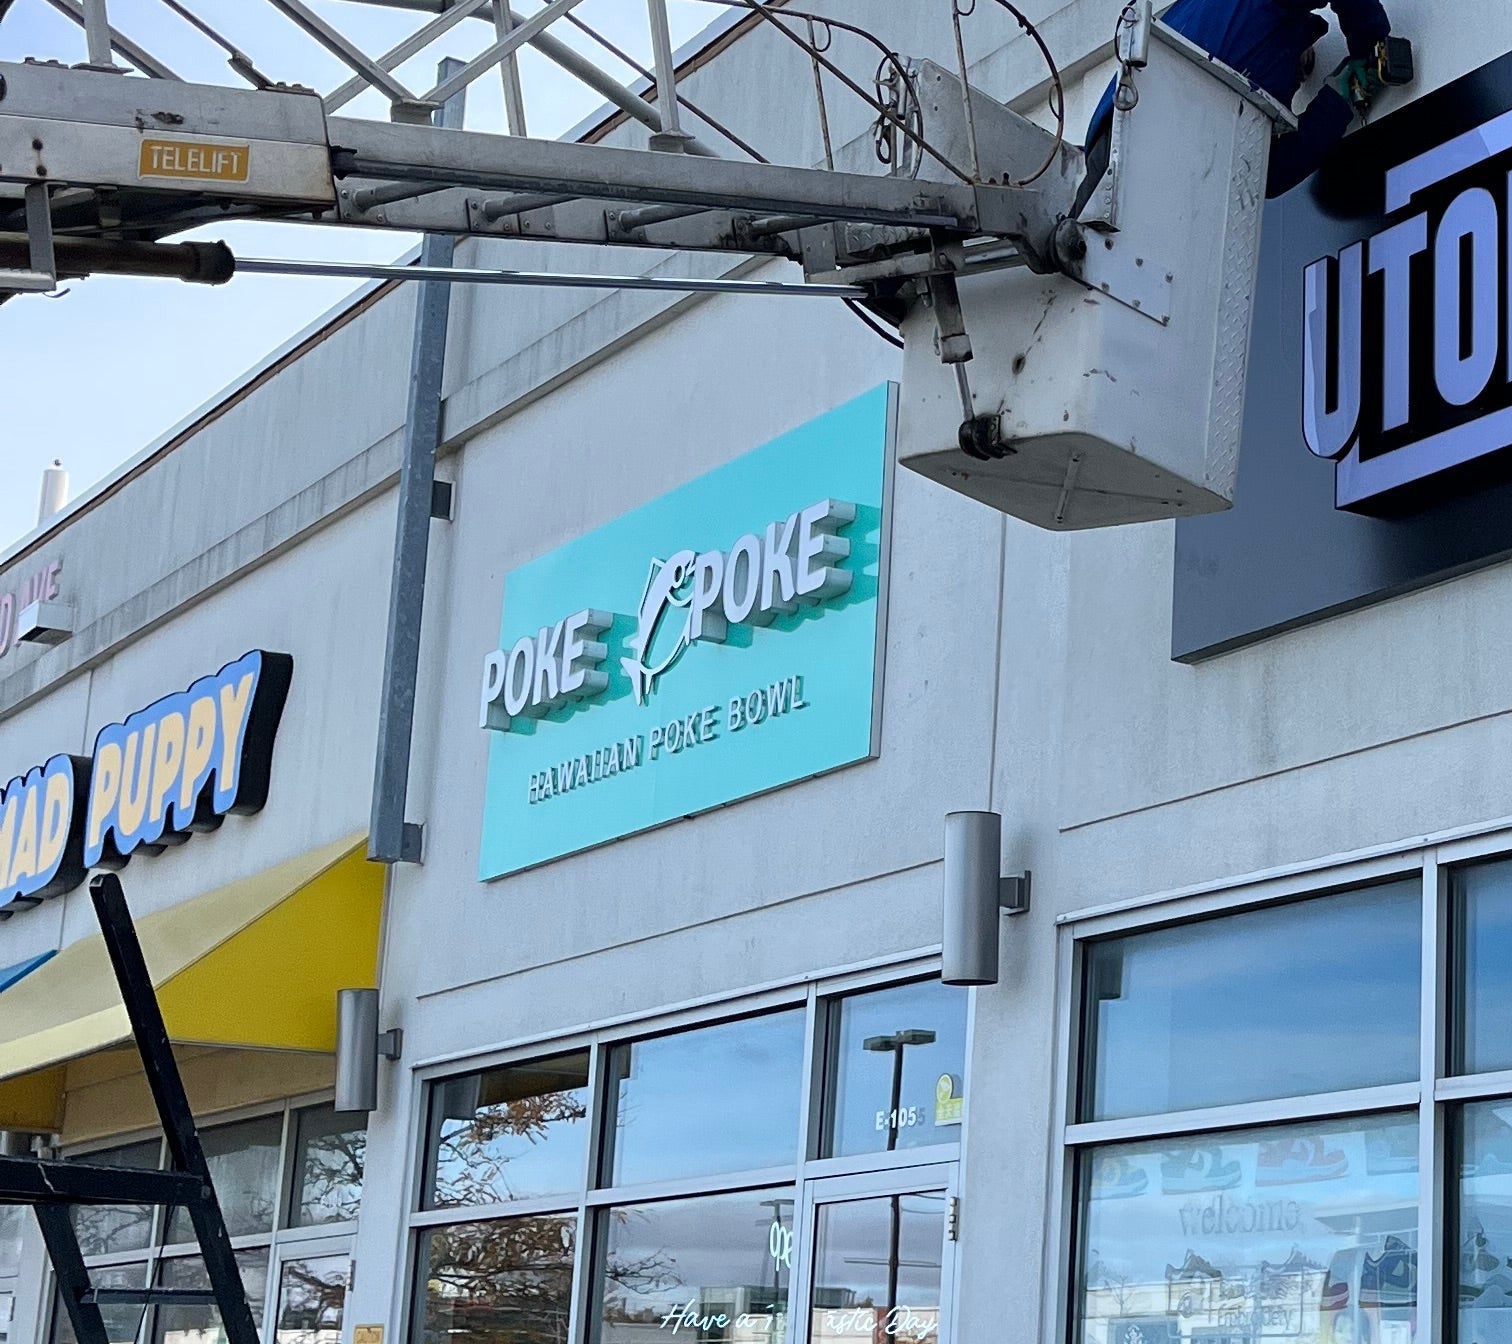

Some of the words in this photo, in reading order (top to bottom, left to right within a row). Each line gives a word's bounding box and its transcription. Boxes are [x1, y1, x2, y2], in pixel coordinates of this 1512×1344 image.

[150, 145, 241, 175] TELELIFT
[480, 607, 606, 729] POKE
[690, 498, 850, 642] POKE
[88, 671, 255, 849] PUPPY
[528, 735, 643, 805] HAWAIIAN
[650, 706, 720, 761] POKE
[728, 675, 807, 731] BOWL
[875, 1106, 917, 1131] E-105
[660, 1299, 731, 1335] Have
[885, 1305, 938, 1339] Day
